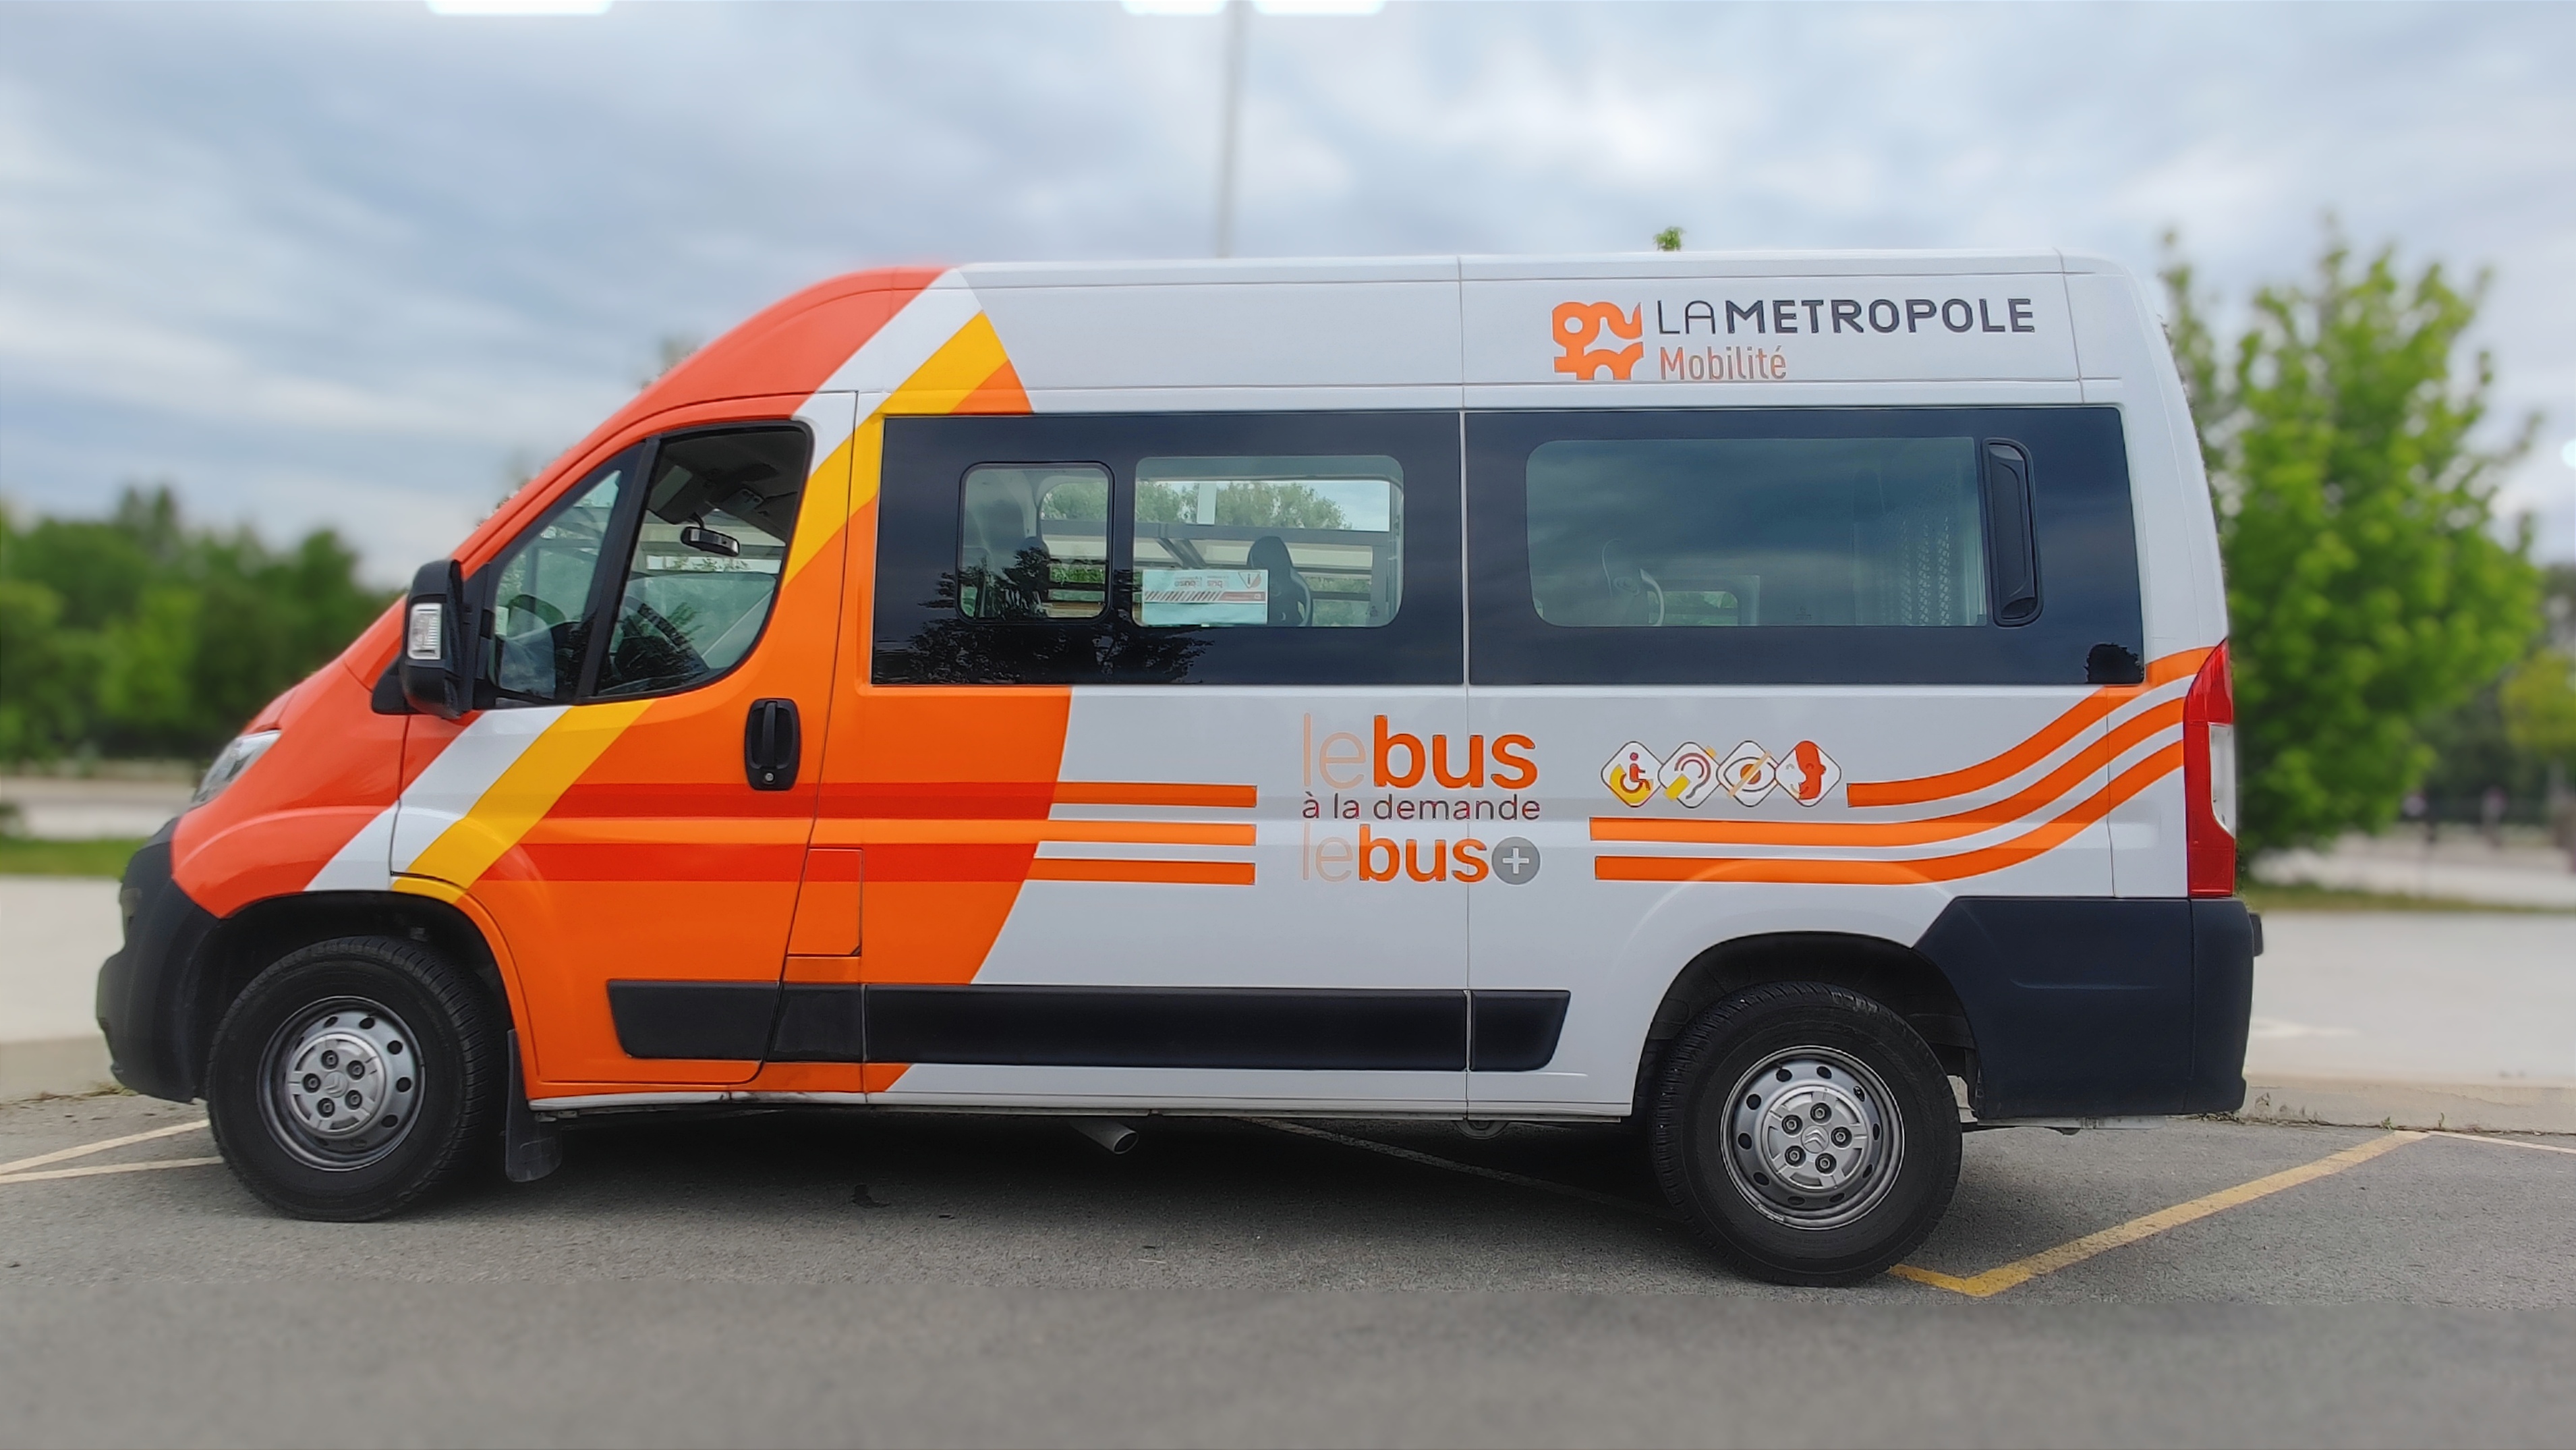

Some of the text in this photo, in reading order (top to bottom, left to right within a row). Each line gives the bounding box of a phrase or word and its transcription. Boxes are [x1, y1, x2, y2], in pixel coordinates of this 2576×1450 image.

[1659, 345, 1787, 380] Mobilité
[1302, 791, 1541, 820] à la demande
